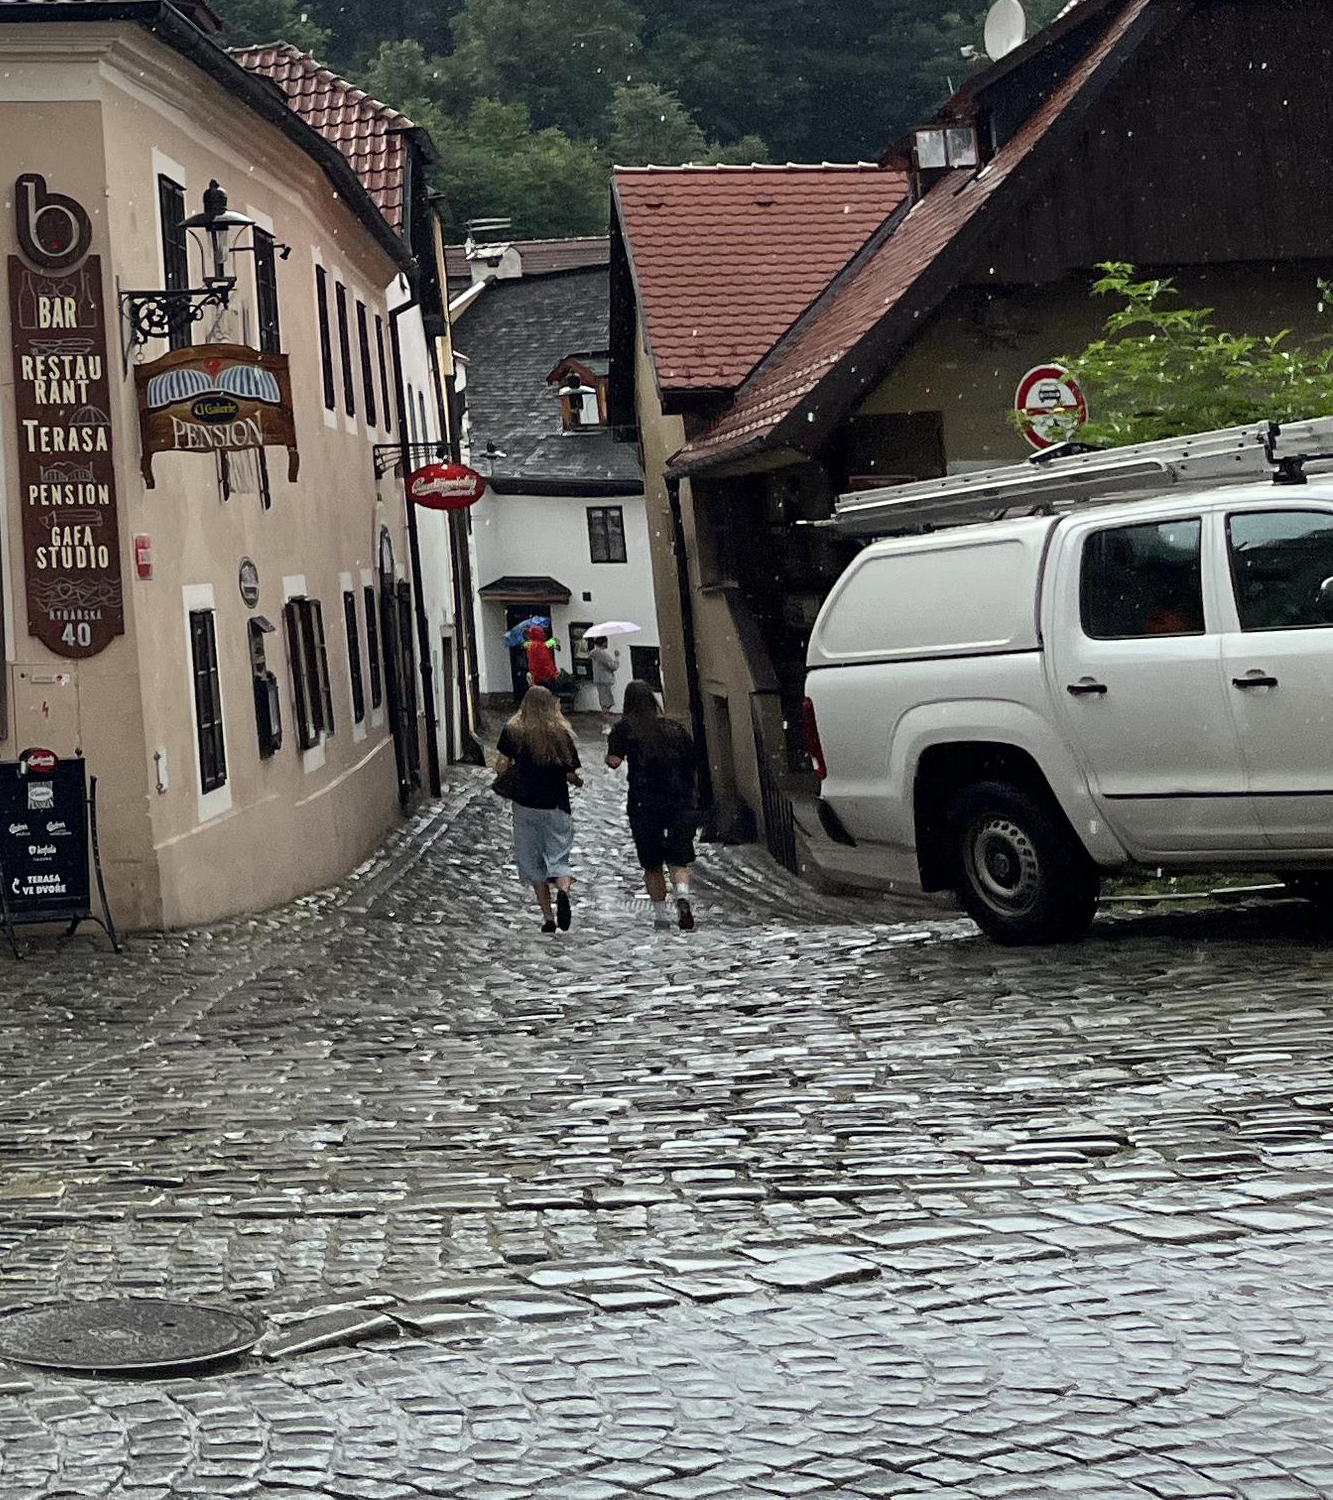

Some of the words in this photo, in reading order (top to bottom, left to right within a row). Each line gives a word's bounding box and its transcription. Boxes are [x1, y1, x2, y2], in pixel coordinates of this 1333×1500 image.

[38, 296, 78, 329] BAR
[21, 354, 103, 381] RESTAU
[34, 378, 91, 405] RANT
[22, 419, 109, 452] TERASA
[169, 410, 264, 449] PENSION
[29, 483, 110, 506] PENSION
[51, 525, 94, 547] GAFA
[35, 544, 110, 570] STUDIO
[60, 622, 93, 648] 40
[22, 886, 35, 895] VE
[27, 874, 61, 885] TERASA
